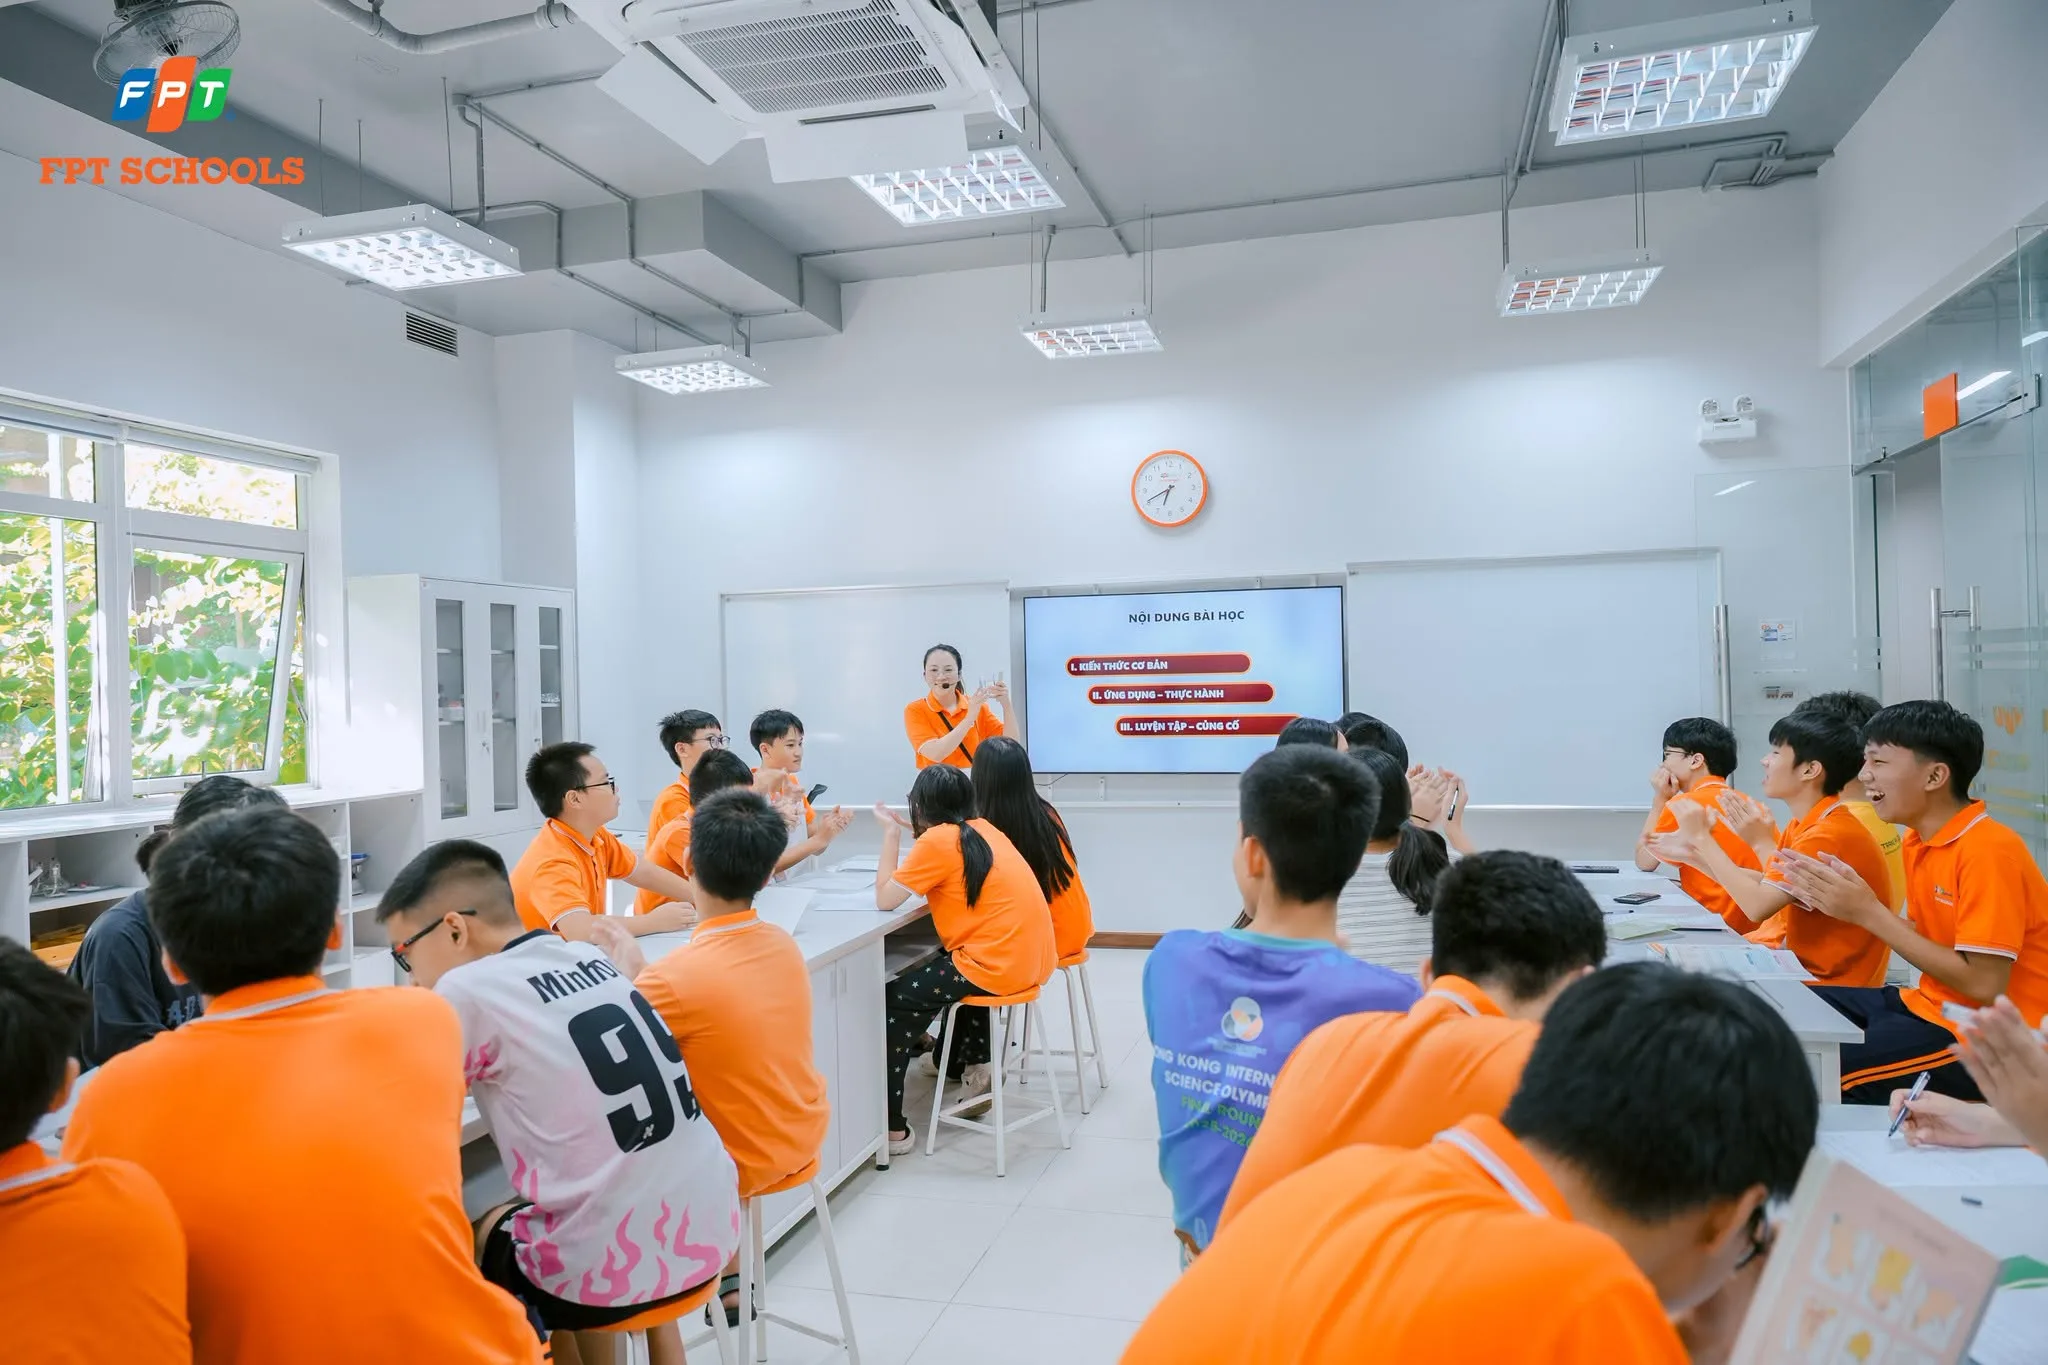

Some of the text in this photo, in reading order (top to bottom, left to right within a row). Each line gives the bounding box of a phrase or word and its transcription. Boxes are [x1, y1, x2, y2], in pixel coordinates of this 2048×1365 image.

[1128, 609, 1245, 625] NỘI DUNG BÀI HỌC
[1079, 660, 1101, 671] KIẾN
[1102, 660, 1130, 671] THỨC
[1131, 661, 1145, 670] CƠ
[1146, 658, 1168, 670] BẢN
[1092, 691, 1102, 700] II.
[1103, 689, 1126, 699] ỨNG
[1127, 690, 1156, 701] DỤNG
[1164, 689, 1192, 700] THỰC
[1193, 688, 1224, 699] HÀNH
[1120, 722, 1133, 731] III.
[1135, 720, 1166, 732] LUYỆN
[1167, 720, 1187, 732] TẬP
[1195, 720, 1224, 731] CỦNG
[1225, 719, 1240, 731] CỐ
[526, 959, 621, 1004] Minho
[1177, 1053, 1221, 1074] KONG
